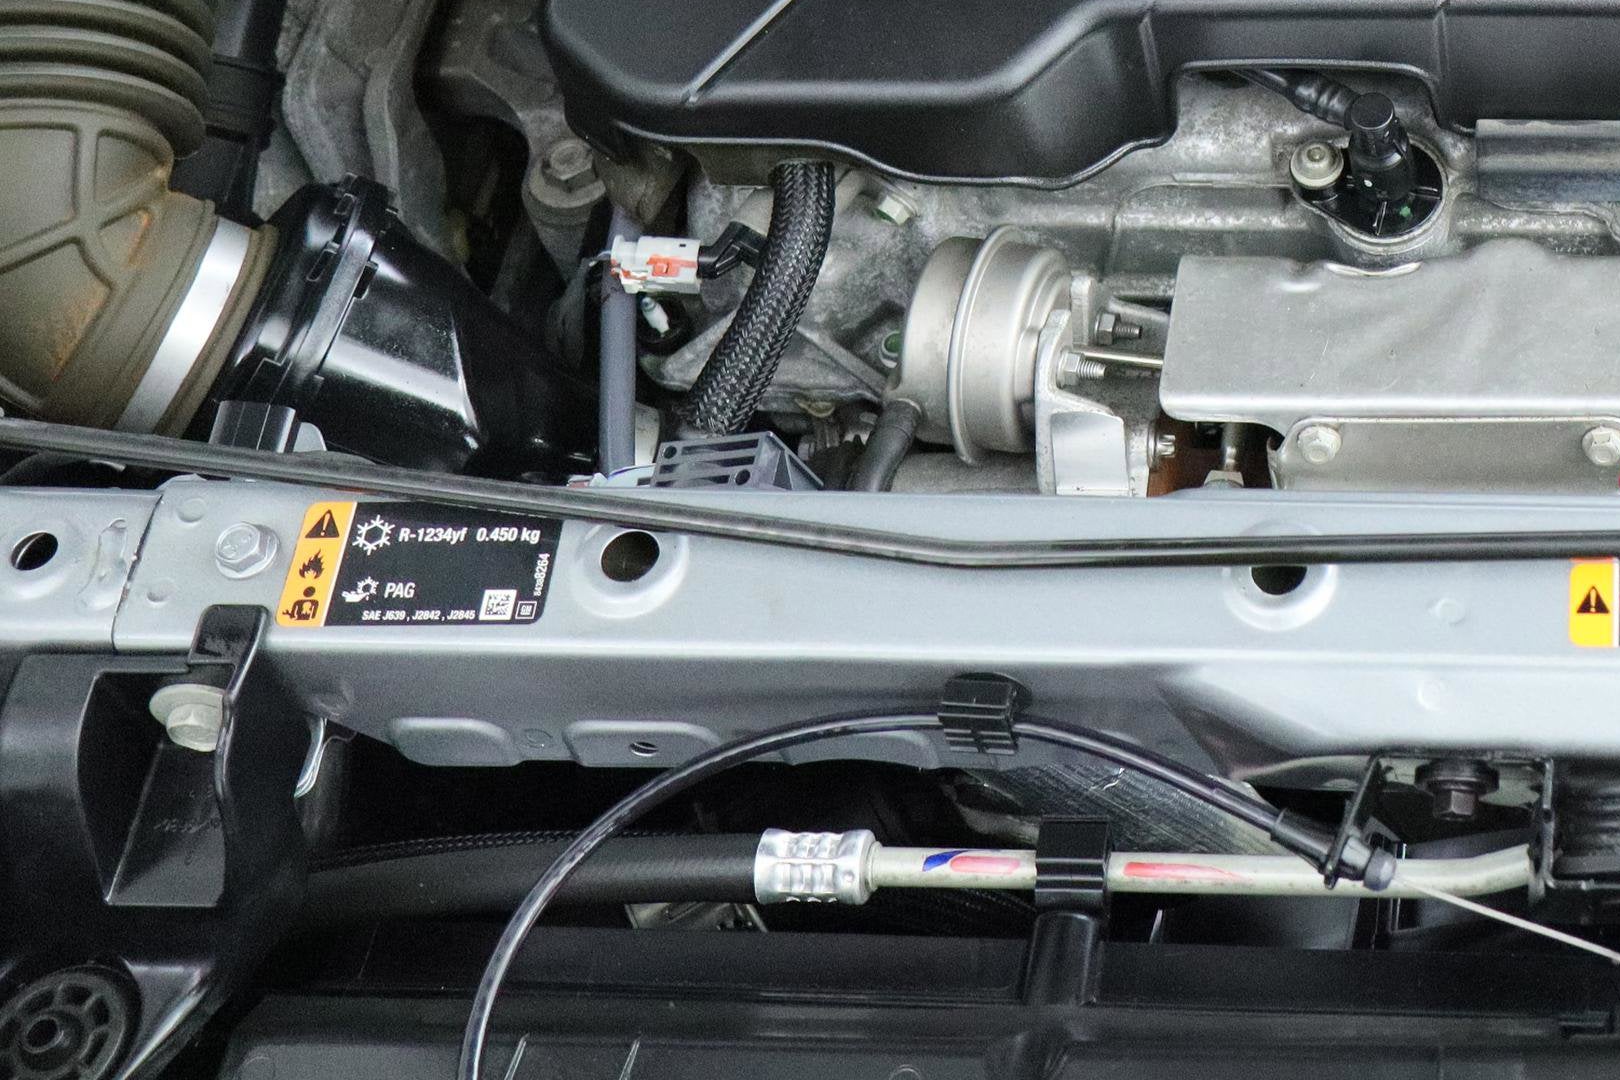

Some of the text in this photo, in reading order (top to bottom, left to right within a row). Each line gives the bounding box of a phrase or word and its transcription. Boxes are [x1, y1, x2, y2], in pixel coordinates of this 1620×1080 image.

[398, 527, 541, 545] R-1234yf 0.450 kg
[384, 582, 416, 599] PAG
[361, 610, 381, 620] SAE
[446, 610, 476, 620] J2845
